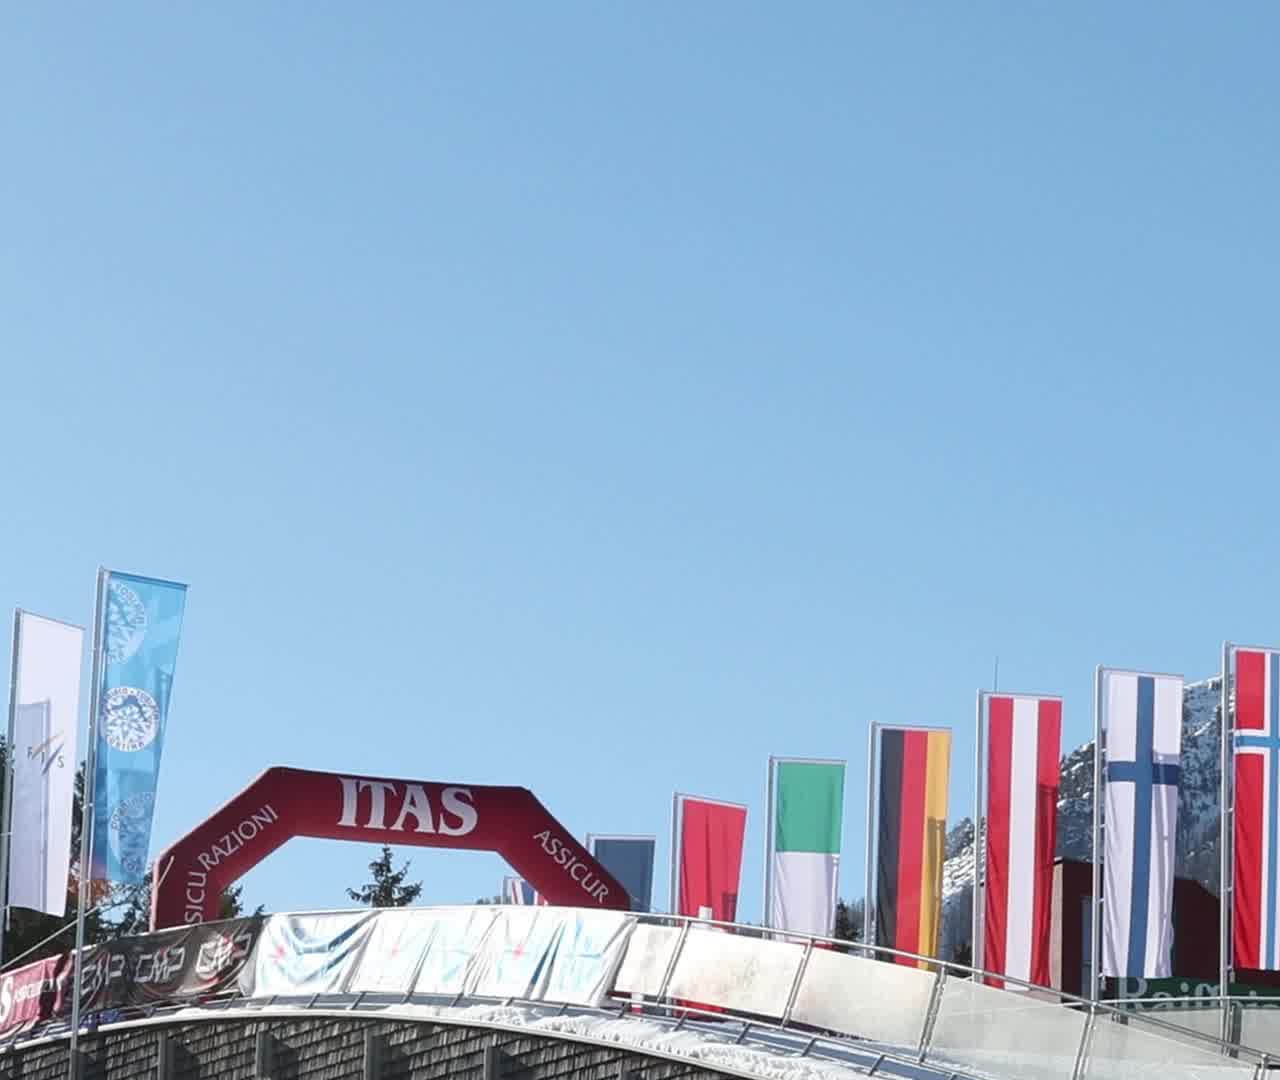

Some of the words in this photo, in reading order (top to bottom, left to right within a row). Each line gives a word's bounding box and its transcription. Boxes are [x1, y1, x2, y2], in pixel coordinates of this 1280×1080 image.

[337, 776, 479, 836] ITAS
[533, 829, 609, 904] ASSICUR
[134, 947, 185, 983] CMP
